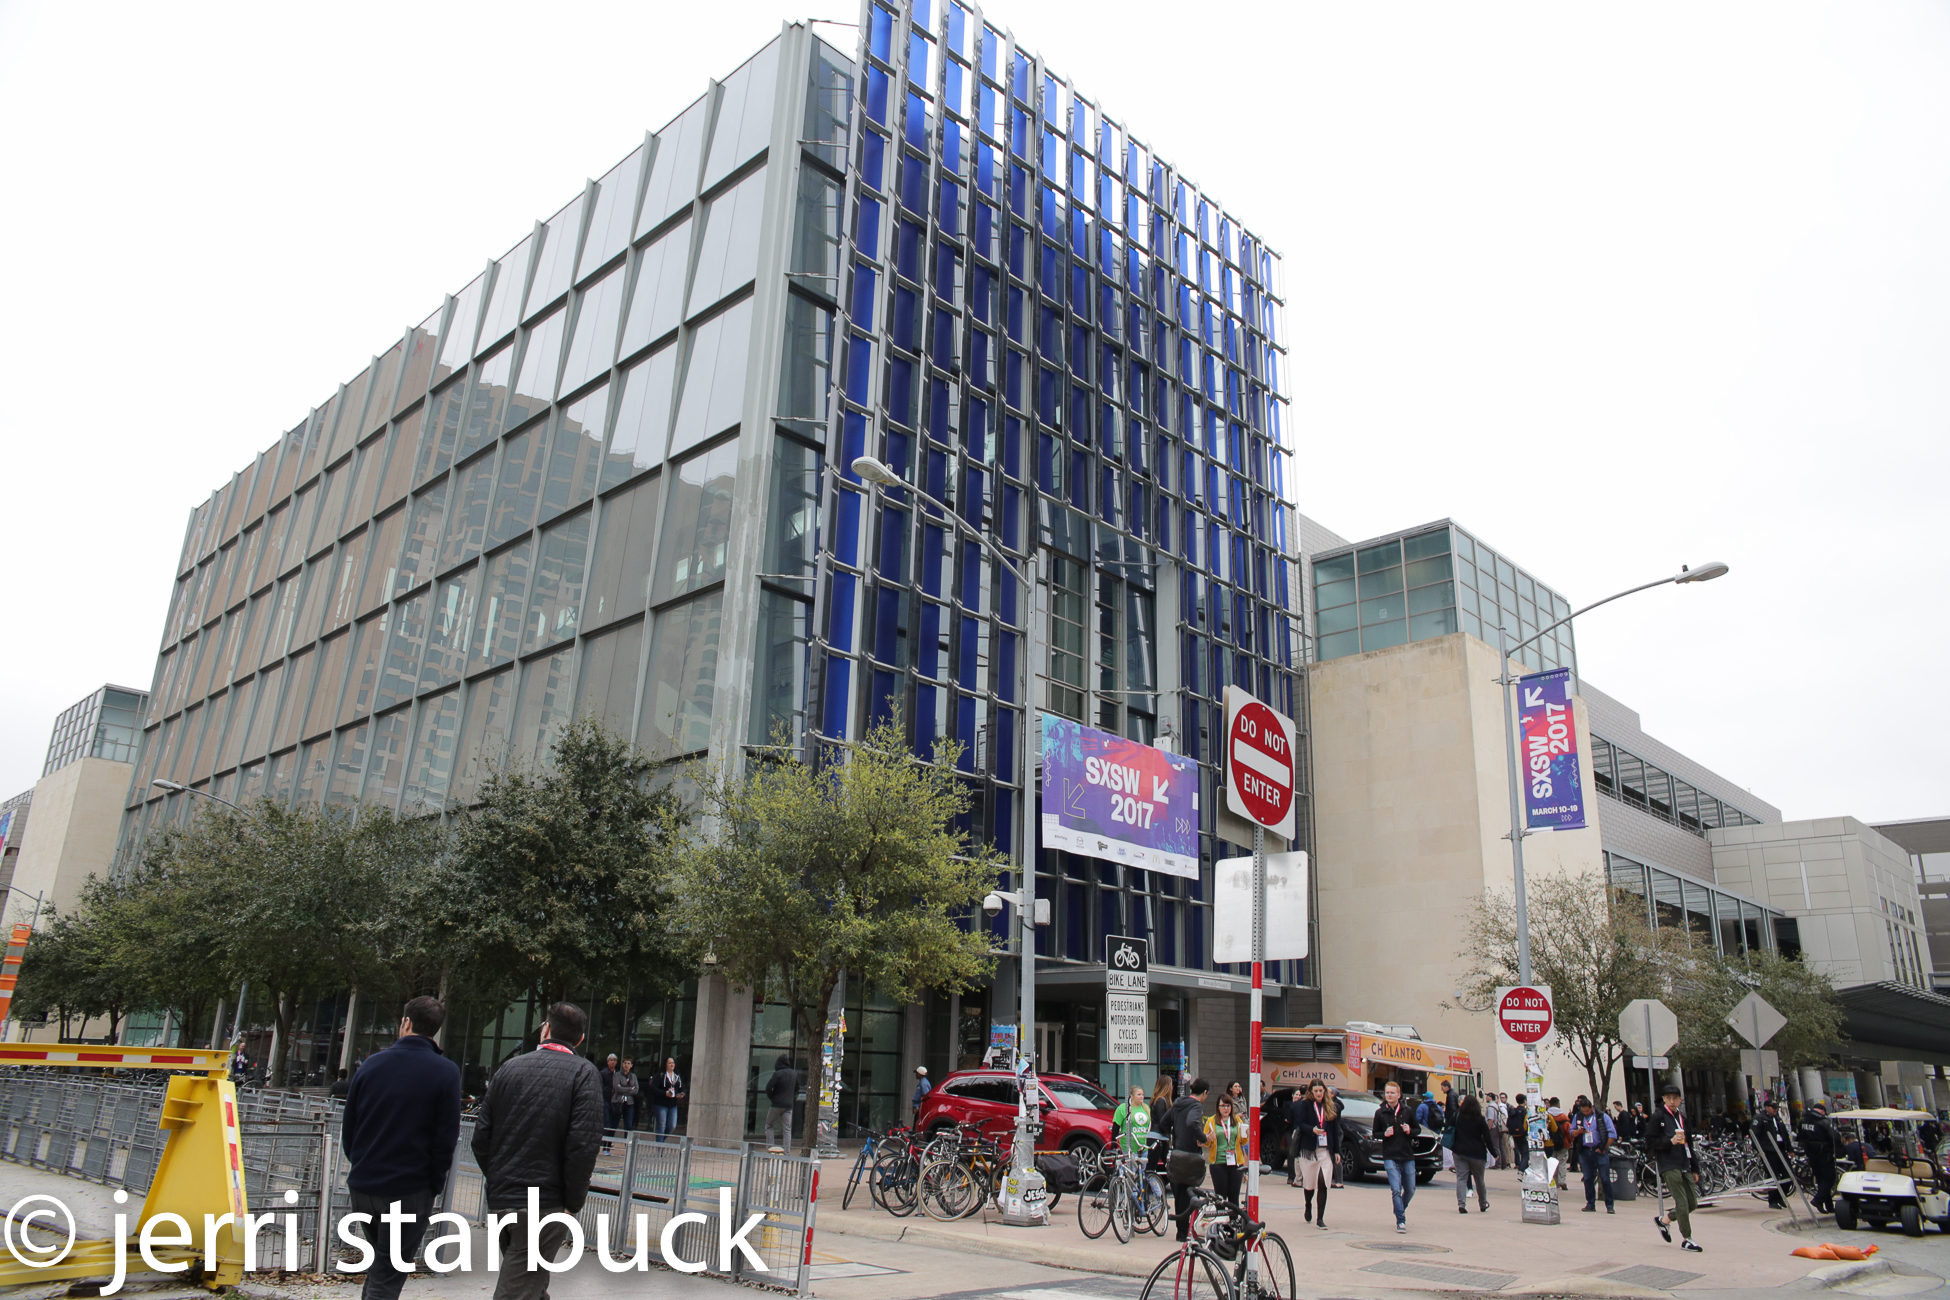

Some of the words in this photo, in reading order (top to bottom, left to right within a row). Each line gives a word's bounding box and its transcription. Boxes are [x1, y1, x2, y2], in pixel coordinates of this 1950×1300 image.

[1240, 714, 1257, 738] DO
[1264, 728, 1286, 755] NOT
[1545, 703, 1570, 754] 2017
[1528, 735, 1553, 799] SXSW
[1086, 756, 1140, 796] SXSW
[1243, 772, 1281, 808] ENTER
[1111, 794, 1154, 829] 2017
[1532, 807, 1558, 816] MARCH
[1558, 804, 1578, 813] 10-19
[1109, 973, 1125, 987] BIKE
[1127, 975, 1146, 988] LANE
[1110, 1000, 1144, 1012] PEDESTRIANS
[1506, 997, 1520, 1007] DO
[1524, 998, 1544, 1008] NOT
[1110, 1015, 1145, 1026] MOTOR-DRIVEN
[1510, 1022, 1541, 1033] ENTER
[1118, 1029, 1138, 1040] CYCLES
[1113, 1043, 1143, 1054] PROHIBITED
[1371, 1041, 1422, 1061] CHI'LANTRO
[1282, 1069, 1336, 1080] CHI'LANTRO
